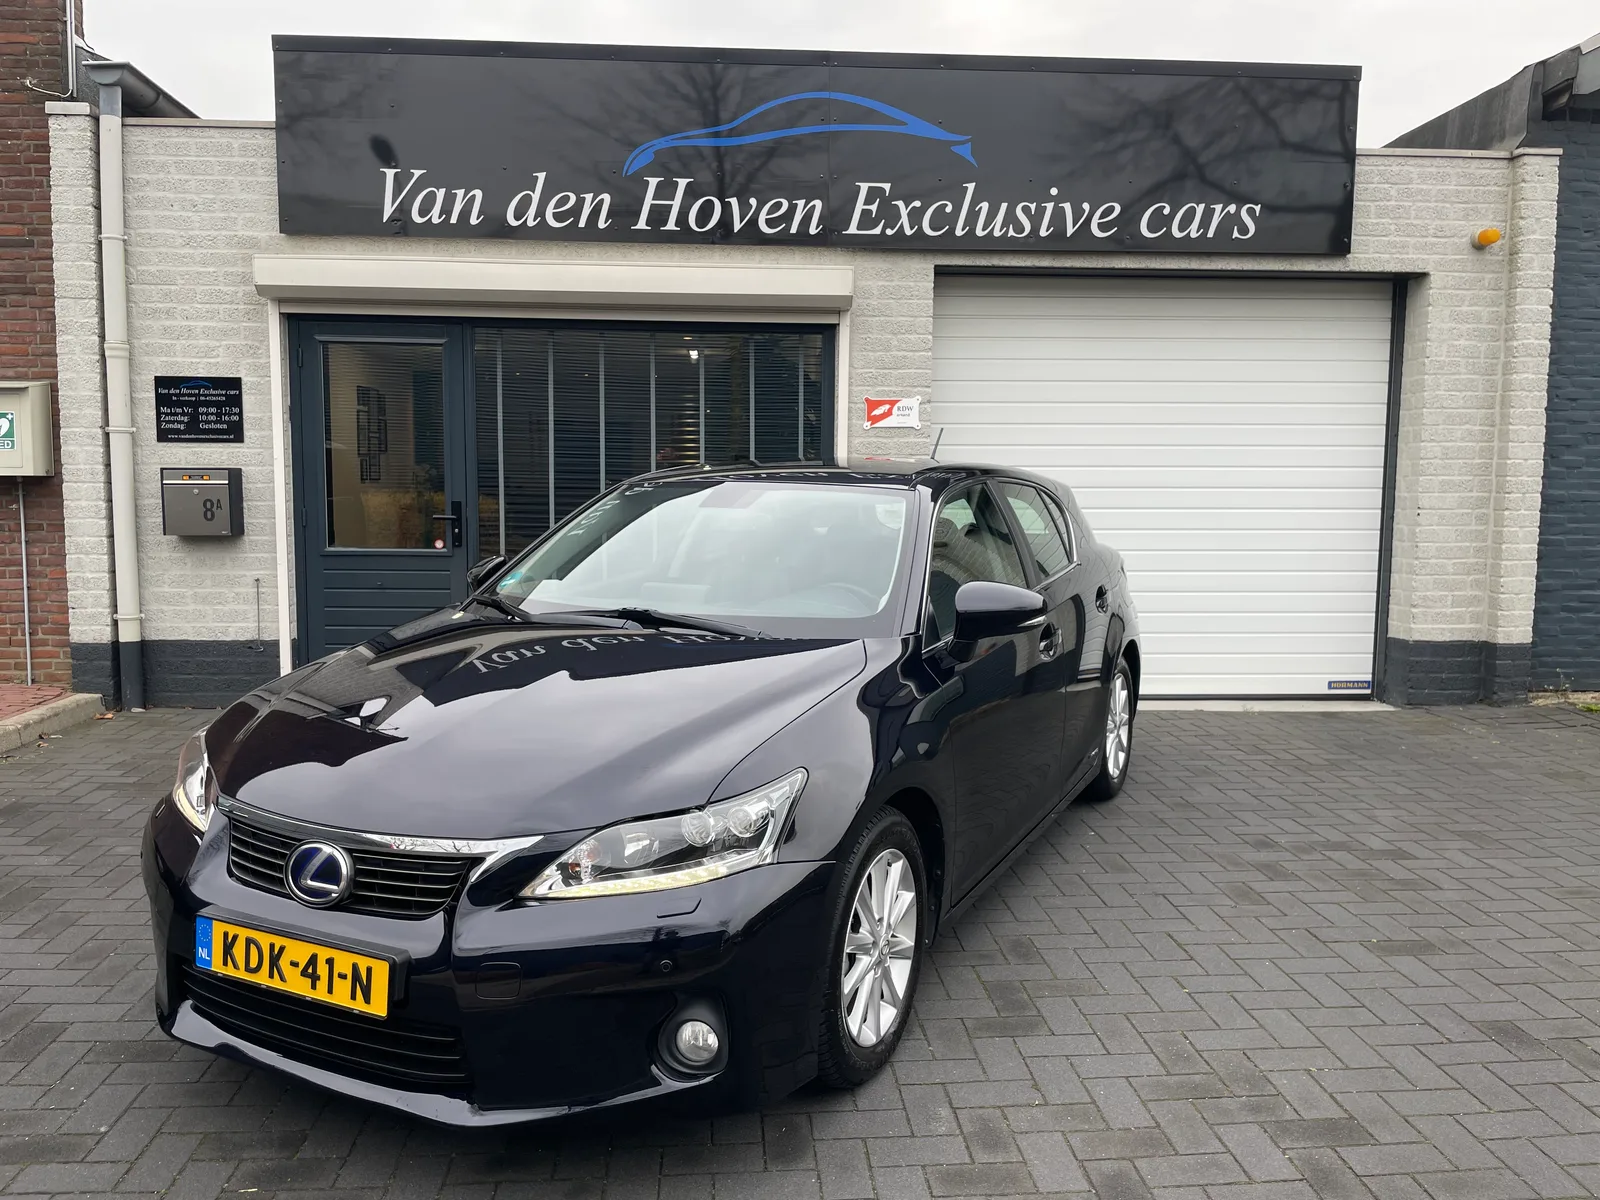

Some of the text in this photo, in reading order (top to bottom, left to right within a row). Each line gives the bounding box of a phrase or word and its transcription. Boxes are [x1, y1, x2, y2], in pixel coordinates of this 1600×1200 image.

[380, 168, 1261, 239] Van den Hoven Exclusive cars
[160, 406, 171, 414] Ma
[171, 406, 182, 414] t/m
[160, 414, 191, 422] Zaterdag:
[161, 422, 187, 430] Zondag:
[198, 946, 211, 961] NL
[222, 930, 373, 1005] KDK-41-N
